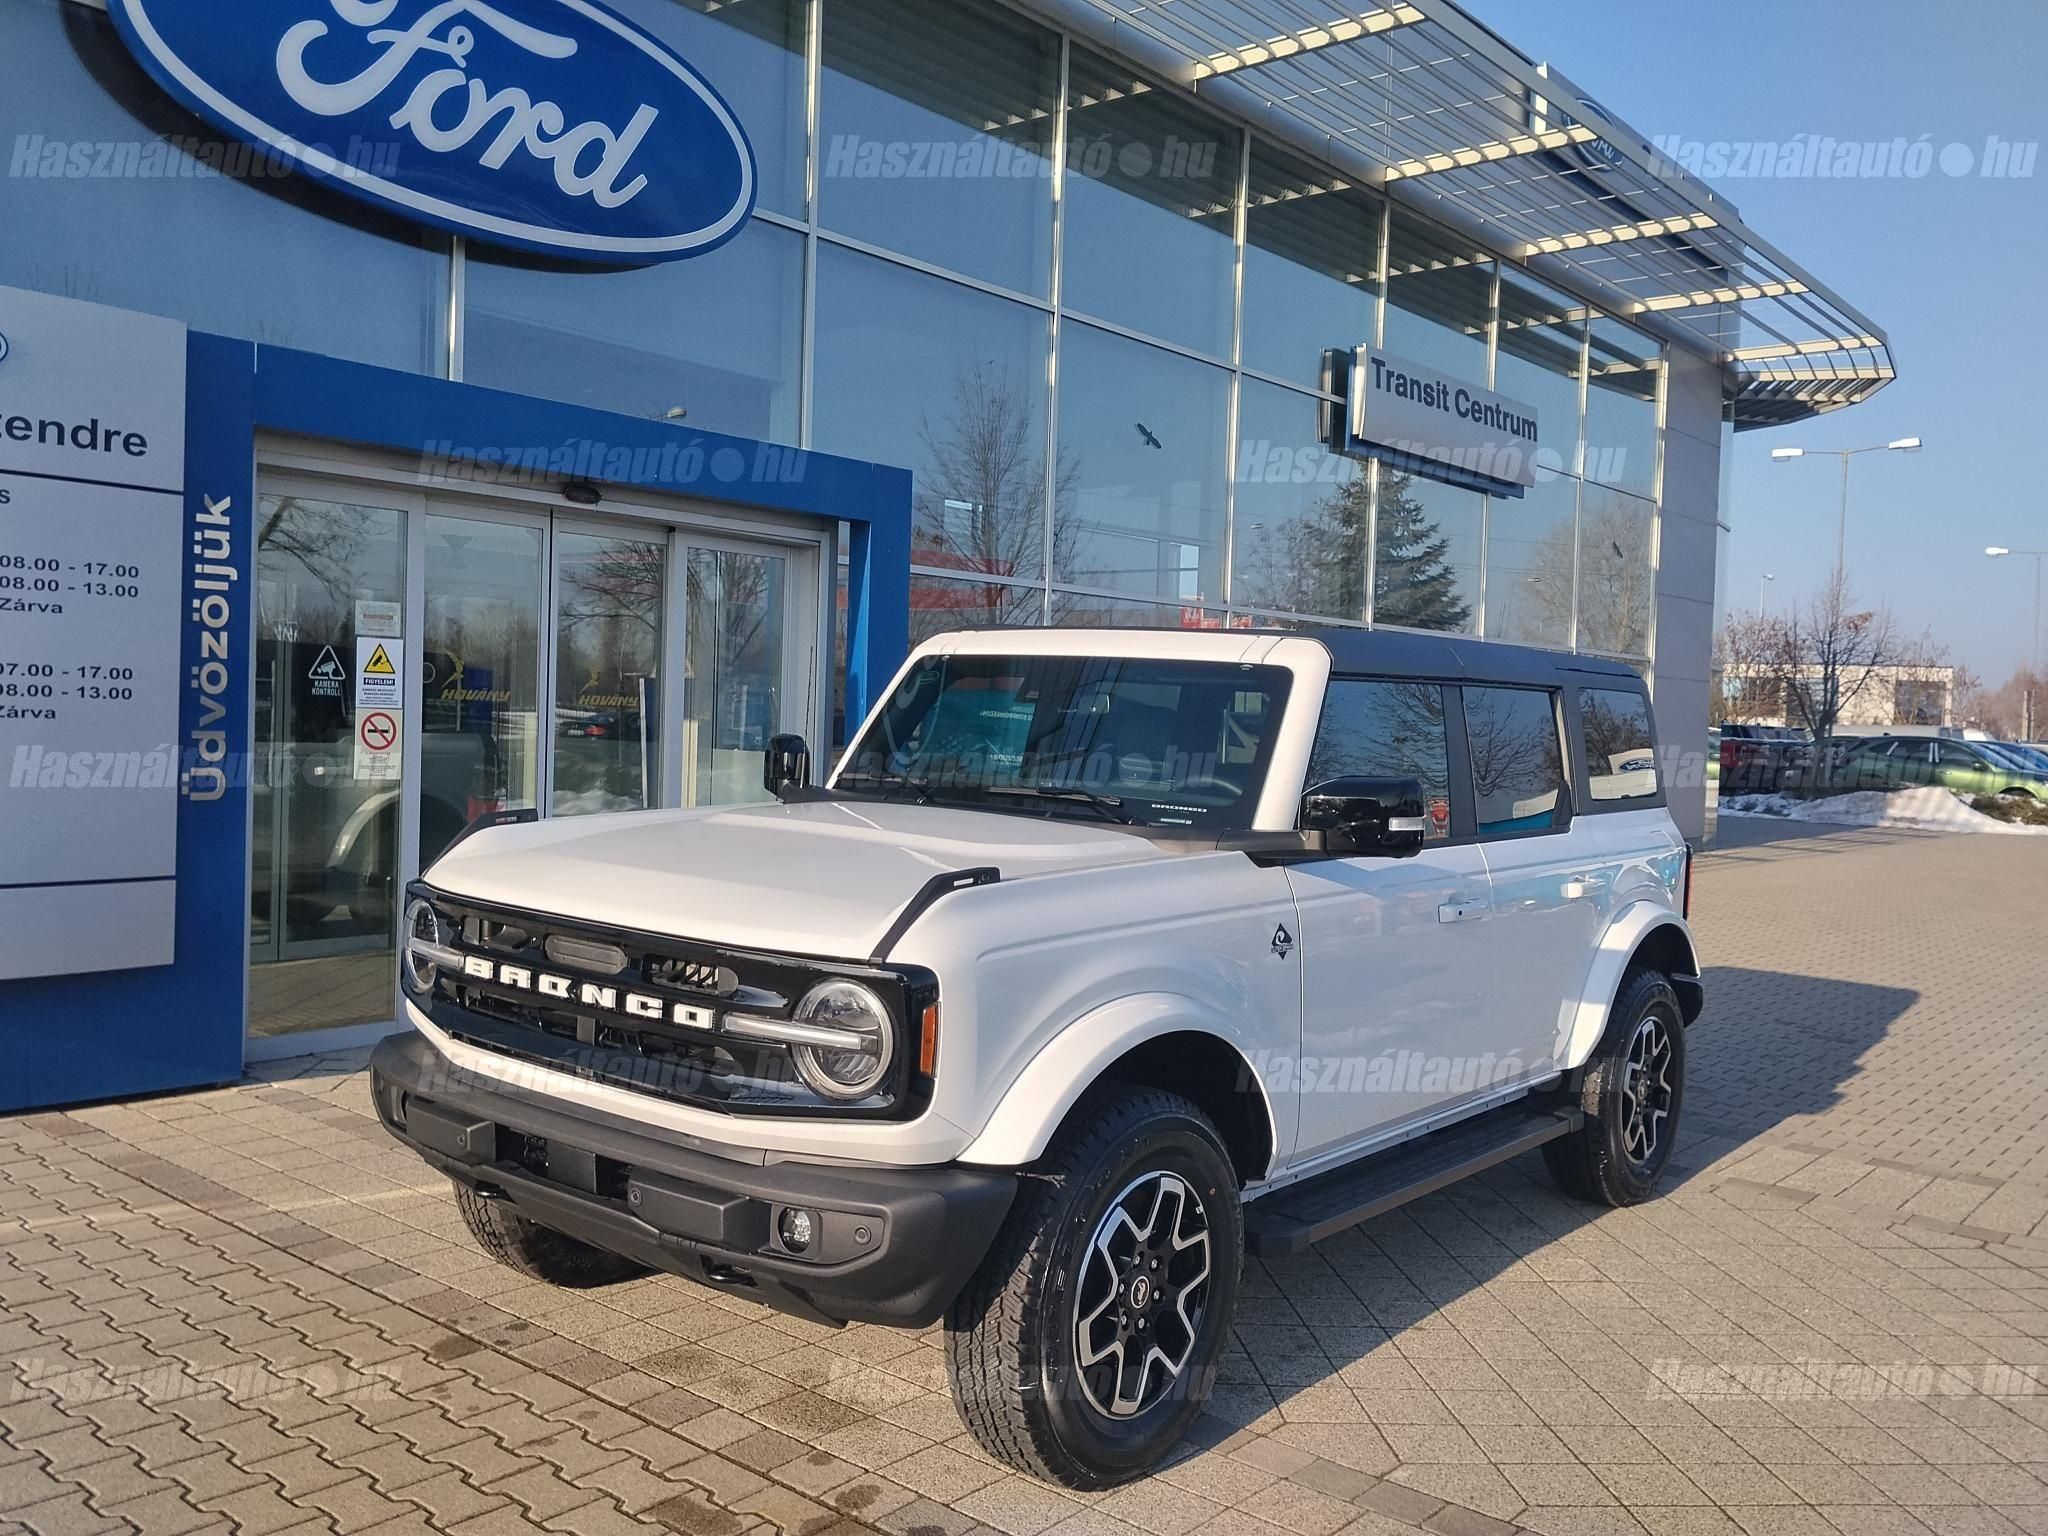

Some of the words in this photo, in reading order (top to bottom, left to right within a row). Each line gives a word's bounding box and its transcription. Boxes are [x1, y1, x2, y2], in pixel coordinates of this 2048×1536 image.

[277, 0, 658, 208] Ford
[1371, 356, 1450, 412] Transit
[1455, 389, 1538, 442] Centrum
[0, 414, 147, 457] endre
[0, 555, 60, 572] 08.00
[83, 562, 139, 578] 17.00
[83, 582, 139, 598] 13.00
[0, 598, 63, 614] Zárva
[182, 493, 237, 801] Üdvözöljük
[77, 666, 133, 680] 17.00
[76, 686, 133, 700] 13.00
[311, 687, 343, 696] KONTROLL
[314, 680, 340, 688] KAMERA
[464, 955, 714, 1029] BRONCO
